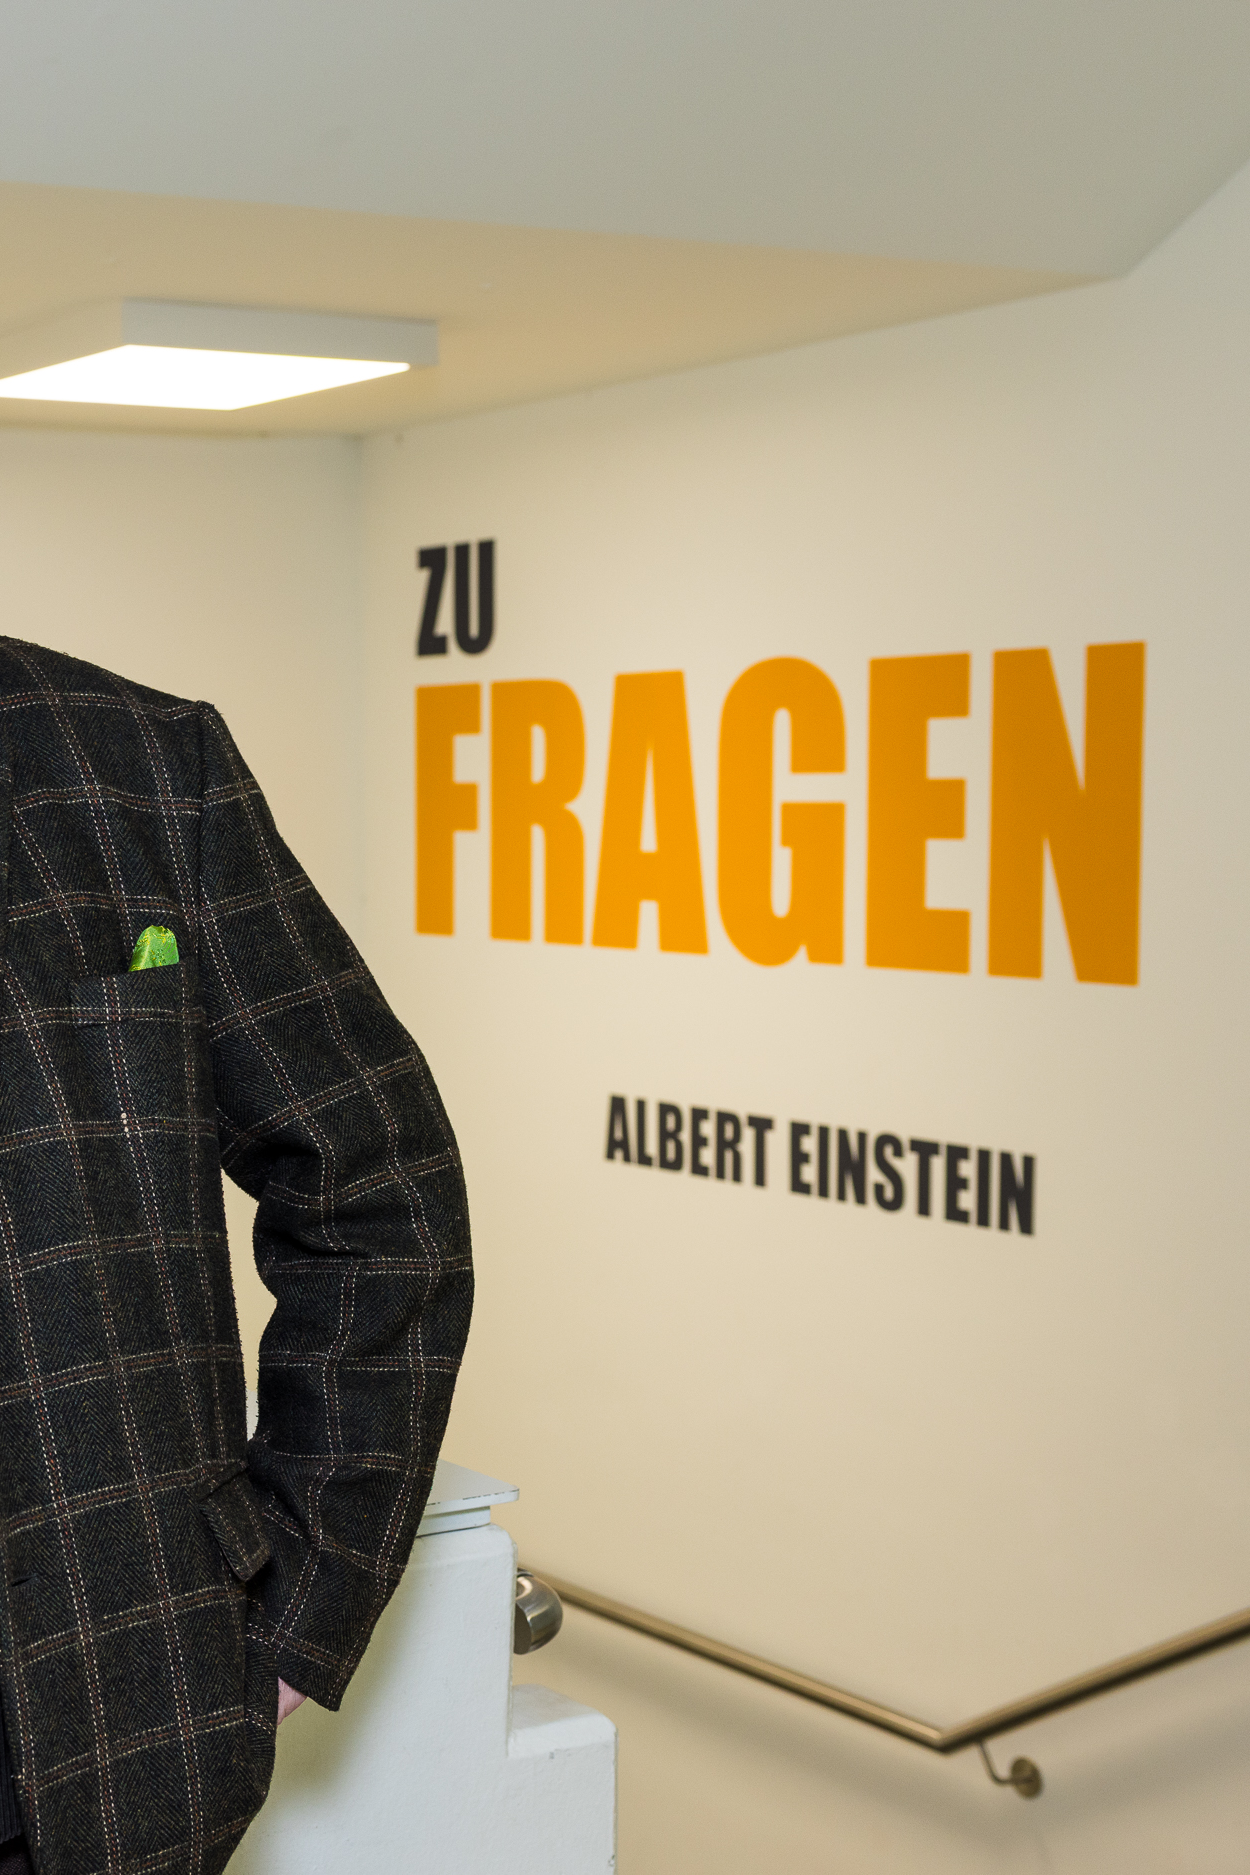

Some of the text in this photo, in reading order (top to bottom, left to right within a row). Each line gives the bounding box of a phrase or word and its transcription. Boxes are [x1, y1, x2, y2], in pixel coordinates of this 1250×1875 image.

[416, 538, 496, 658] ZU
[414, 640, 1147, 988] FRAGEN
[604, 1094, 1036, 1237] ALBERT EINSTEIN
